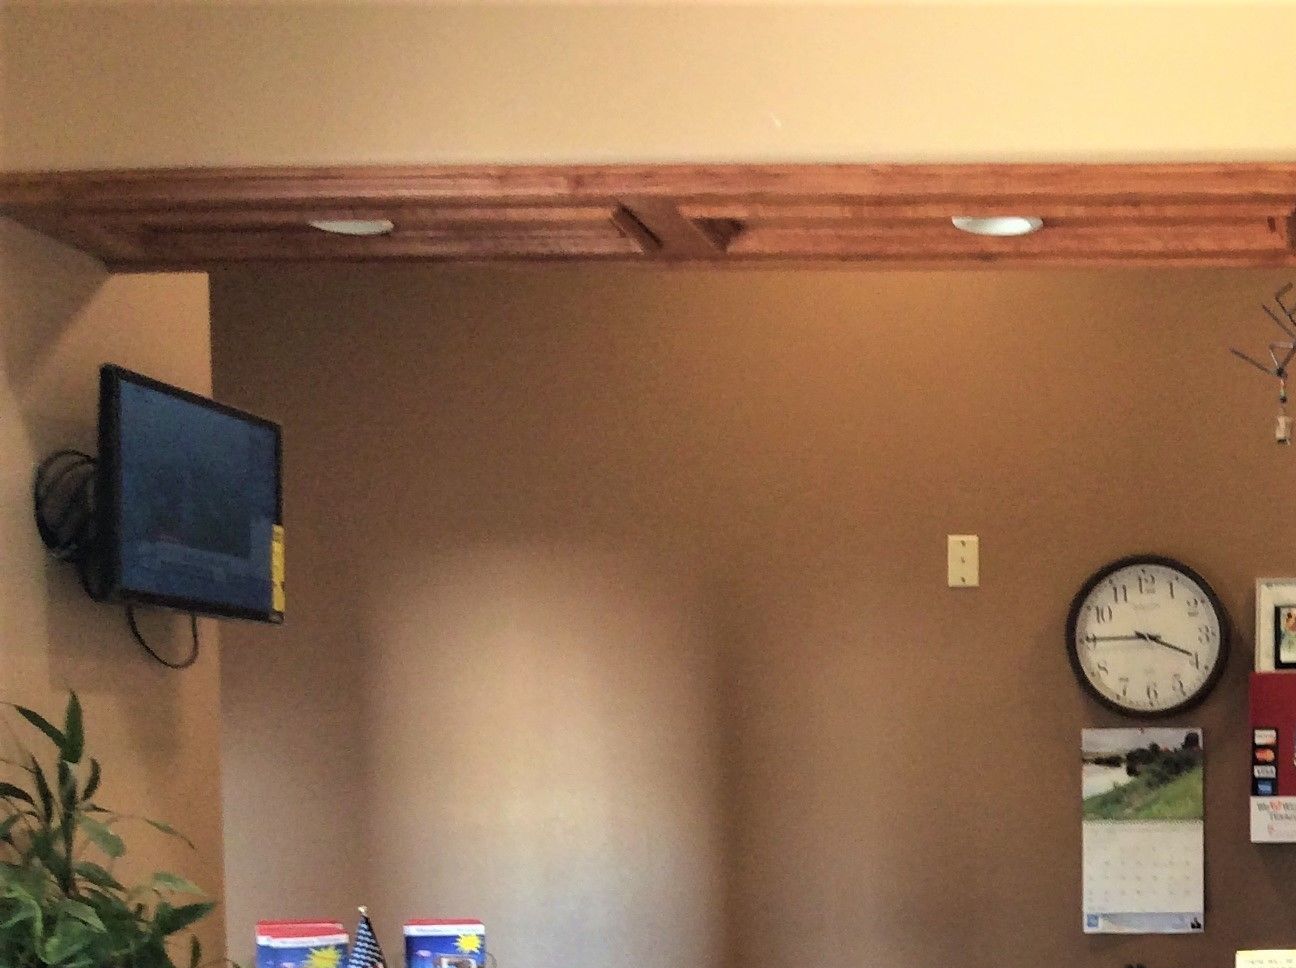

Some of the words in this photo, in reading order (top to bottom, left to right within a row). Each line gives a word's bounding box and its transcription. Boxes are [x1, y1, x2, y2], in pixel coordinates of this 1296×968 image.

[1112, 584, 1128, 603] 11
[1138, 574, 1156, 594] 12
[1095, 605, 1113, 623] 10
